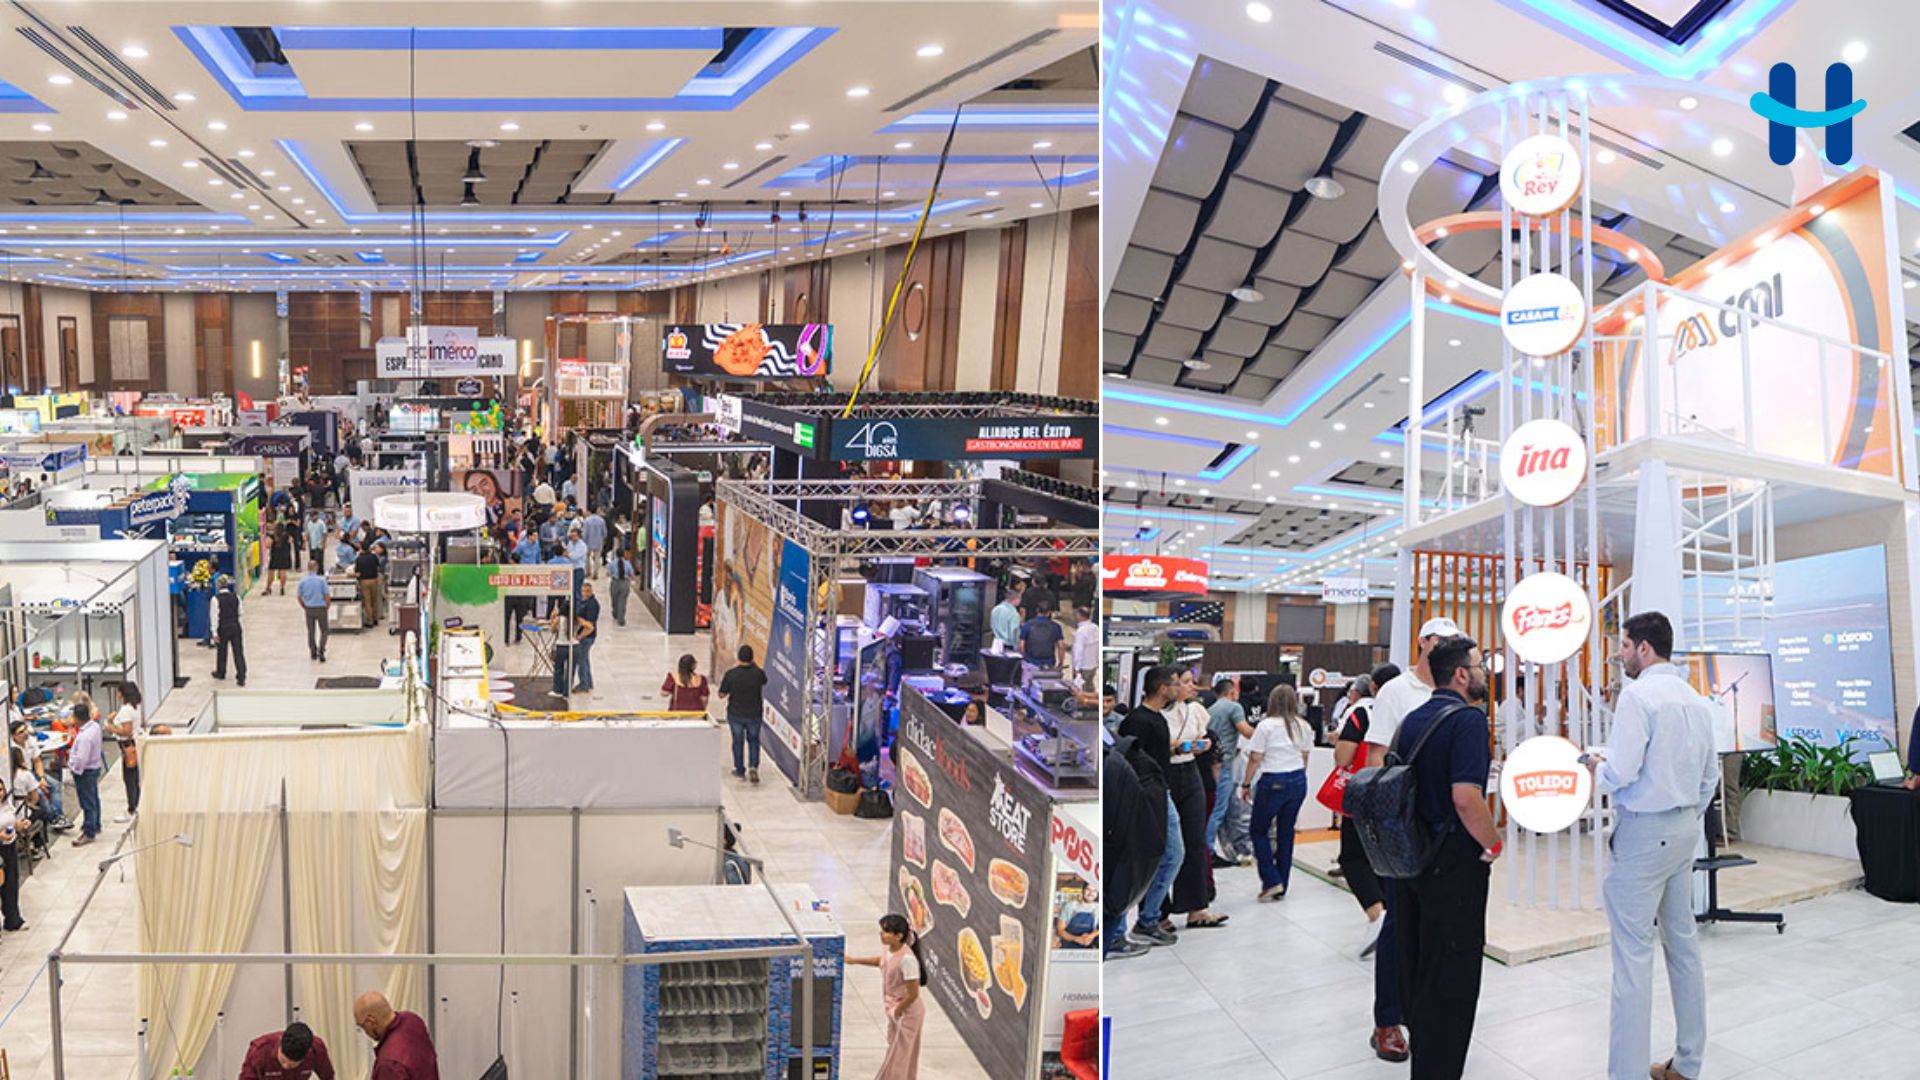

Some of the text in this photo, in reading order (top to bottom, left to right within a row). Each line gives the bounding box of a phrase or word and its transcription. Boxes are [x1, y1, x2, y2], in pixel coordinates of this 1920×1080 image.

[428, 340, 477, 360] imerco
[978, 423, 1072, 438] ALIADOS DEL ÉXITO
[865, 445, 898, 458] DIGSA
[1517, 445, 1570, 477] ina
[1516, 774, 1573, 793] TOLEDO
[989, 806, 1027, 855] STORE
